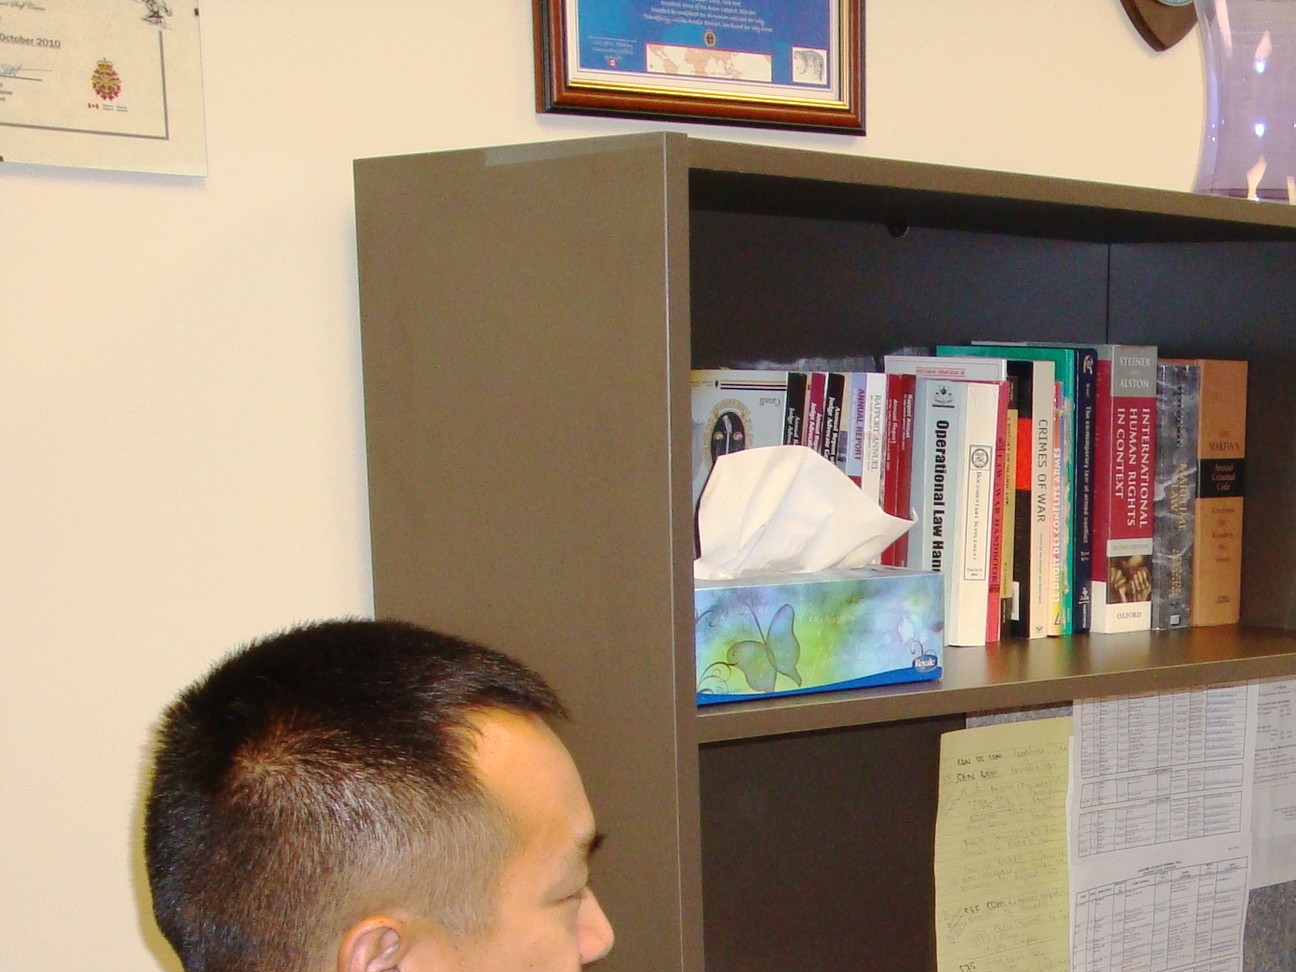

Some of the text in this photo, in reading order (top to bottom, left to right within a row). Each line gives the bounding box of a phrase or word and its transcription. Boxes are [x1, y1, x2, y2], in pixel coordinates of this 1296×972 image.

[0, 33, 61, 48] October 2010
[1119, 357, 1151, 367] STEINER
[1119, 379, 1149, 389] ALSTON
[827, 397, 835, 416] Judge
[855, 388, 865, 461] ANNUAL REPORT
[890, 422, 898, 444] Report
[871, 435, 879, 472] ANNUEL
[934, 420, 950, 506] Operational
[1037, 419, 1048, 522] CRIMES OF WAR
[1115, 407, 1125, 499] IN CONTEXT
[1127, 407, 1138, 526] HUMAN RIGHTS
[1139, 407, 1150, 528] INTERNATIONAL
[1053, 486, 1061, 534] CONFLITS
[1170, 483, 1180, 512] LAW
[1178, 463, 1188, 530] MARITIME
[933, 510, 945, 537] Law
[1053, 592, 1060, 603] LE
